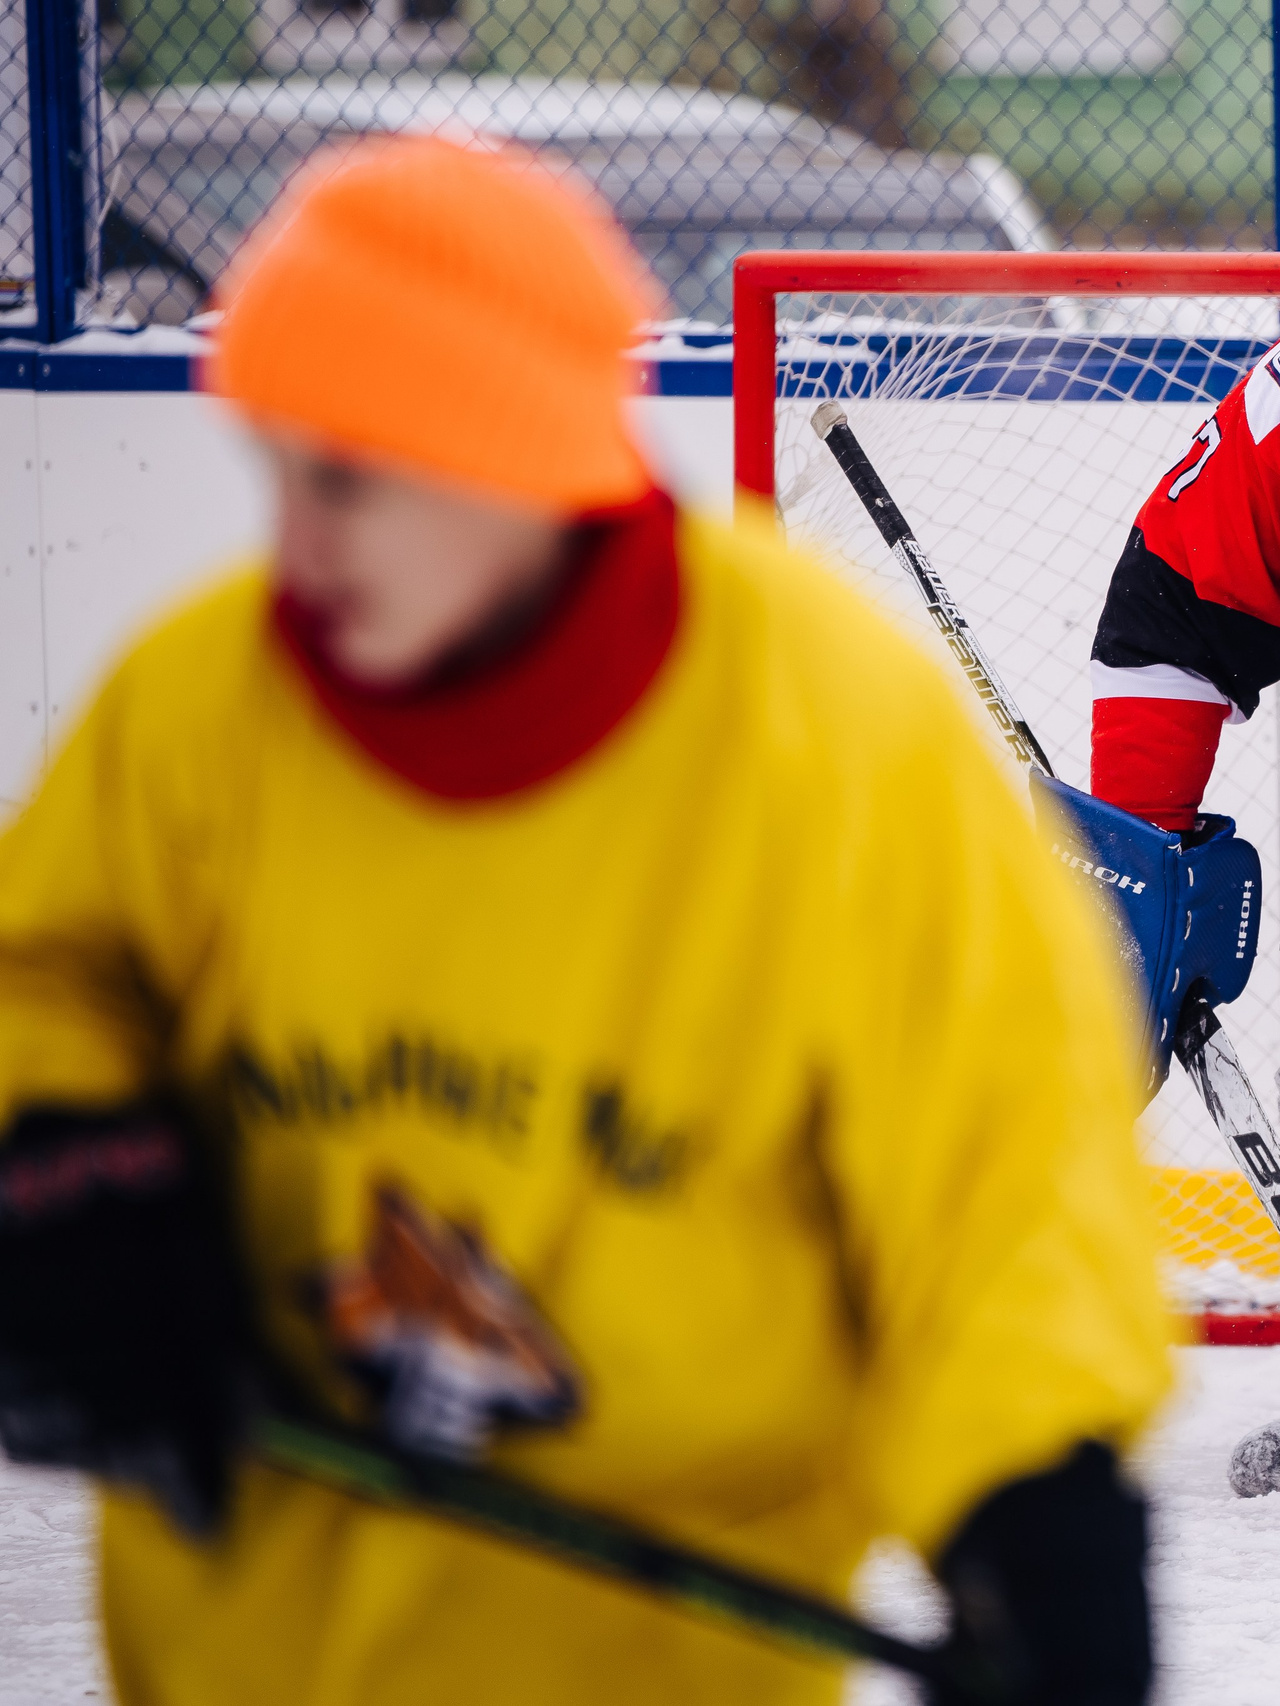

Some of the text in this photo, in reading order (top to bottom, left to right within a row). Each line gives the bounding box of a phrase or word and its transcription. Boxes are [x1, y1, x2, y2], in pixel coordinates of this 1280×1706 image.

[926, 604, 1032, 765] BAUER
[1051, 843, 1147, 895] KROK
[1235, 880, 1254, 959] KROK
